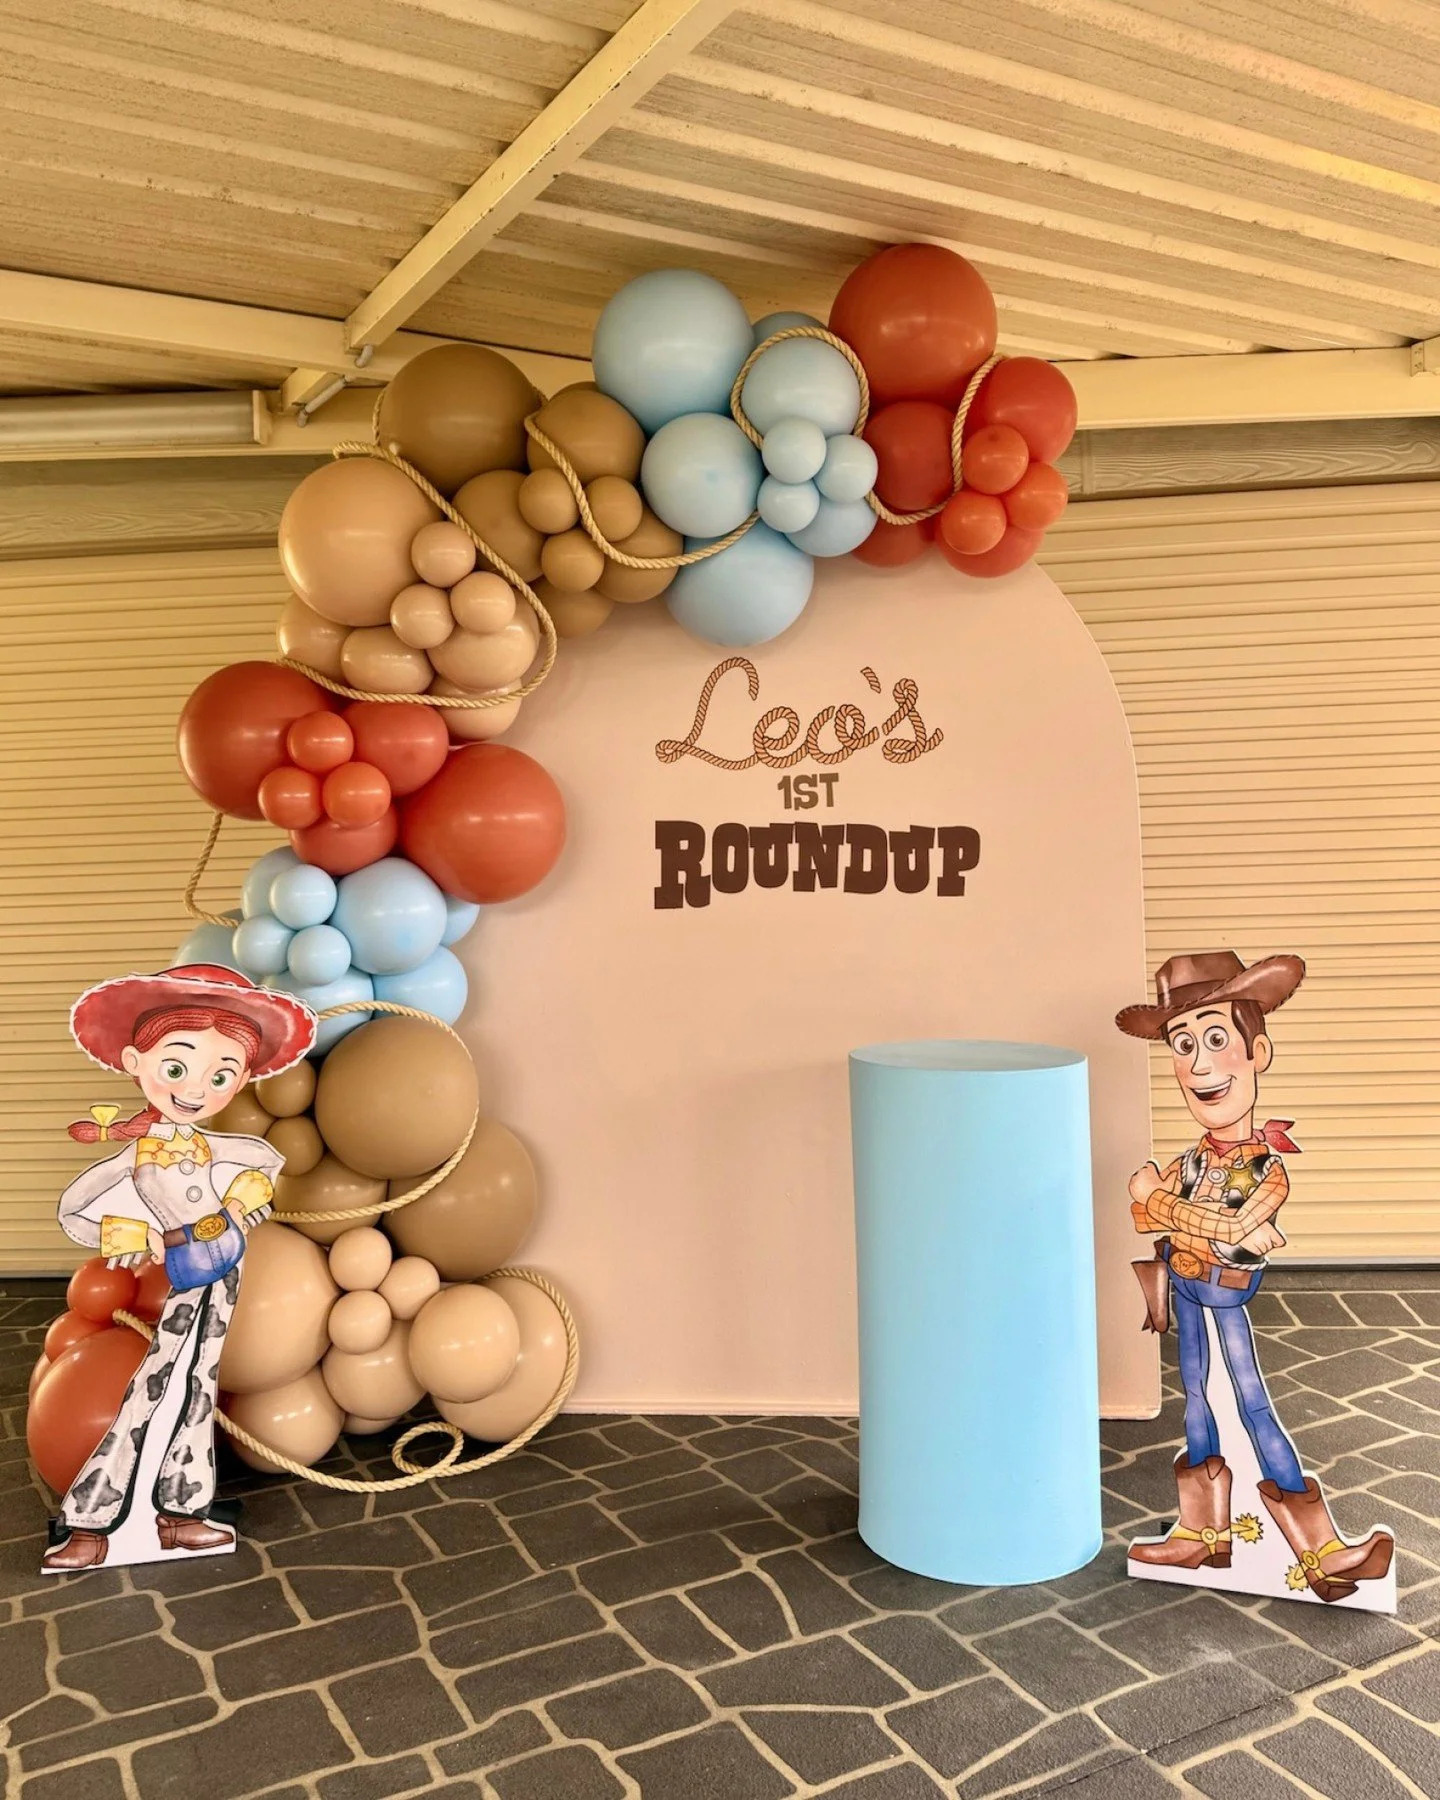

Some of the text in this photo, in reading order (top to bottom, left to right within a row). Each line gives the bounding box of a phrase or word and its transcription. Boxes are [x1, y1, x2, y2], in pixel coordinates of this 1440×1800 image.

[655, 657, 944, 771] Leo's
[777, 772, 840, 811] 1ST
[653, 820, 981, 910] ROUNDUP
